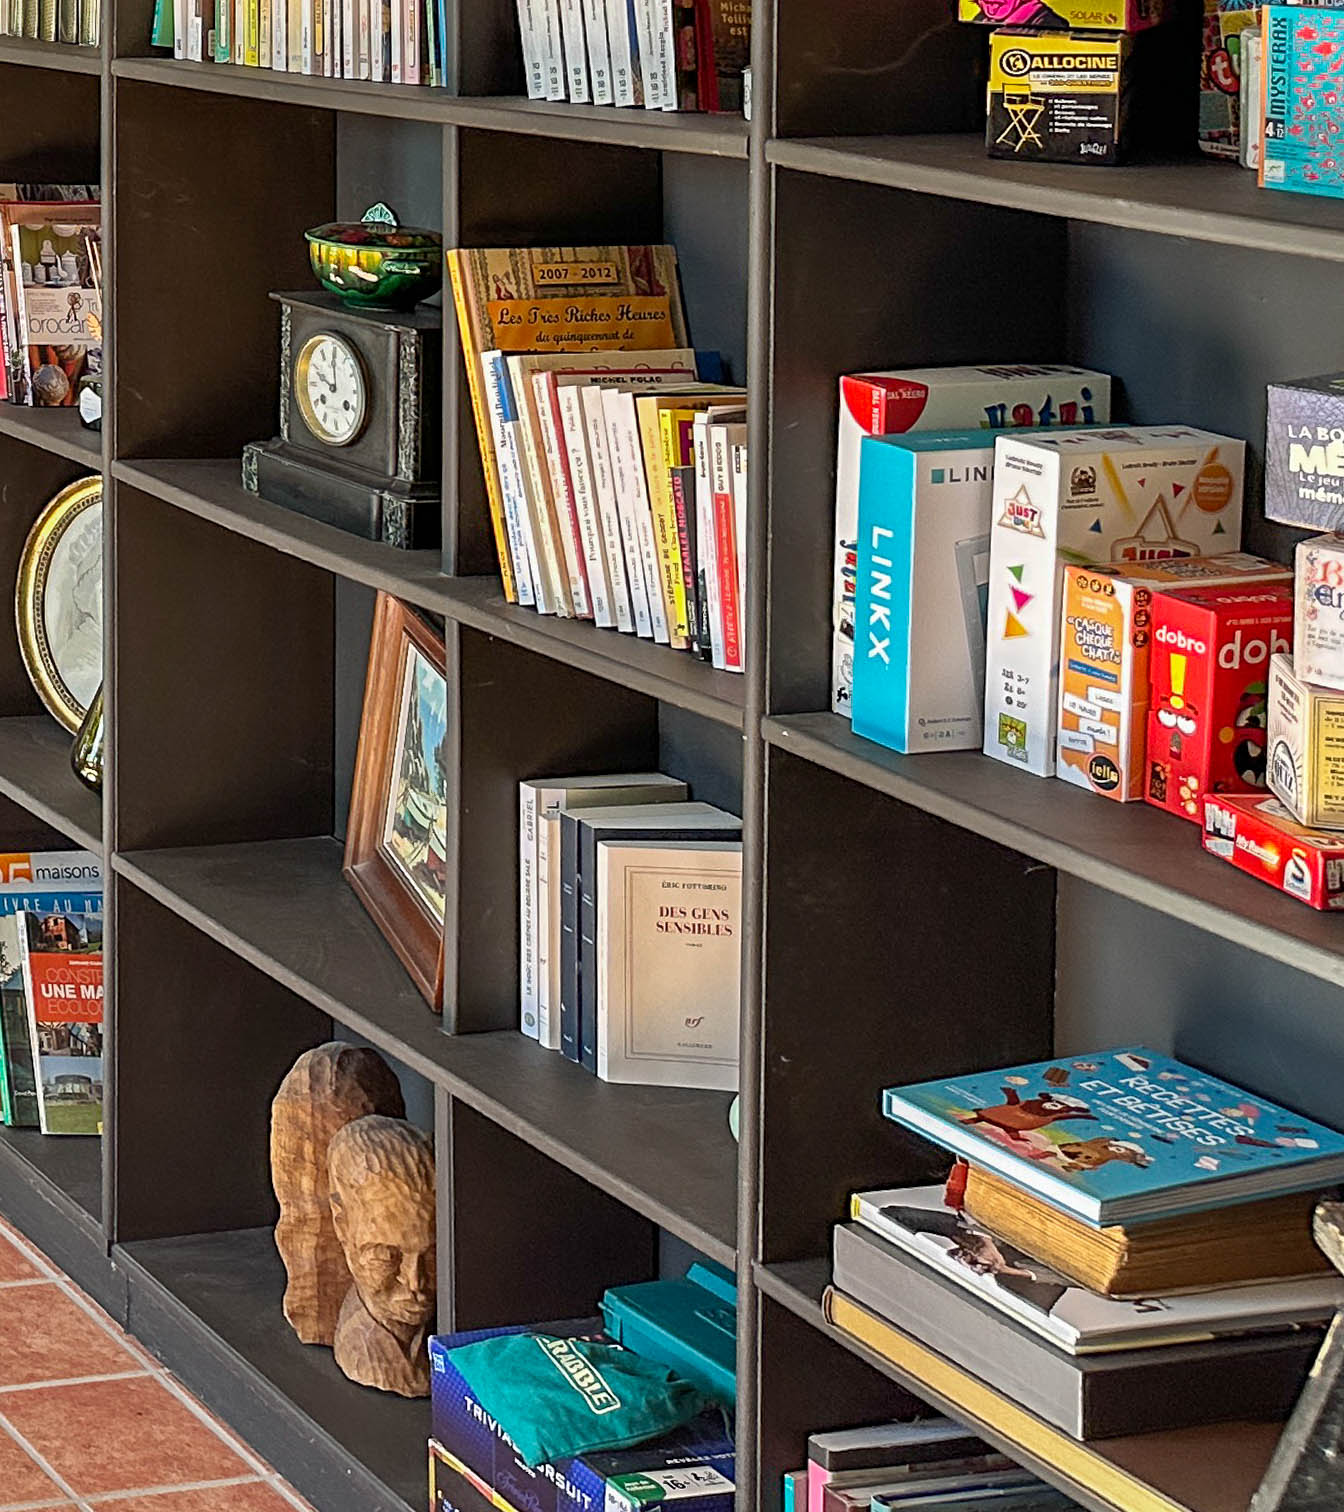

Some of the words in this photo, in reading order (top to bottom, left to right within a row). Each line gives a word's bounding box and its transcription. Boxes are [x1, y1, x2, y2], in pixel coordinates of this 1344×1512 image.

[722, 13, 752, 25] Tolli
[1070, 10, 1103, 21] SOLAR
[730, 27, 748, 37] est
[1032, 56, 1117, 70] ALLOCINE
[1270, 16, 1288, 116] MYSTERAX
[539, 268, 569, 280] 2007
[581, 267, 612, 279] 2012
[498, 307, 522, 326] Les
[564, 305, 611, 324] Riches
[616, 303, 666, 322] Heures
[536, 331, 550, 343] du
[553, 329, 619, 345] quinquennat
[622, 330, 635, 340] de
[591, 376, 627, 384] MICHEL
[1287, 424, 1312, 439] LA
[714, 442, 724, 473] BEDOS
[949, 466, 995, 483] LIN
[1299, 471, 1316, 483] Le
[1317, 474, 1340, 488] jeu
[717, 474, 726, 492] GUY
[673, 476, 688, 528] MOSCATO
[1007, 502, 1038, 521] JUST
[684, 576, 693, 589] LE
[868, 525, 894, 665] LINKX
[1155, 624, 1206, 655] dobro
[526, 799, 534, 842] GABRIEL
[36, 865, 100, 880] maisons
[661, 880, 680, 889] ÉRIC
[53, 899, 72, 913] AU
[659, 906, 688, 919] DES
[691, 907, 729, 922] GENS
[656, 920, 733, 937] SENSIBLES
[41, 984, 77, 998] UNE
[685, 1016, 704, 1029] nrf
[1079, 1079, 1115, 1099] ET
[1111, 1093, 1227, 1147] BÊTISES
[1119, 1075, 1255, 1137] RECETTES
